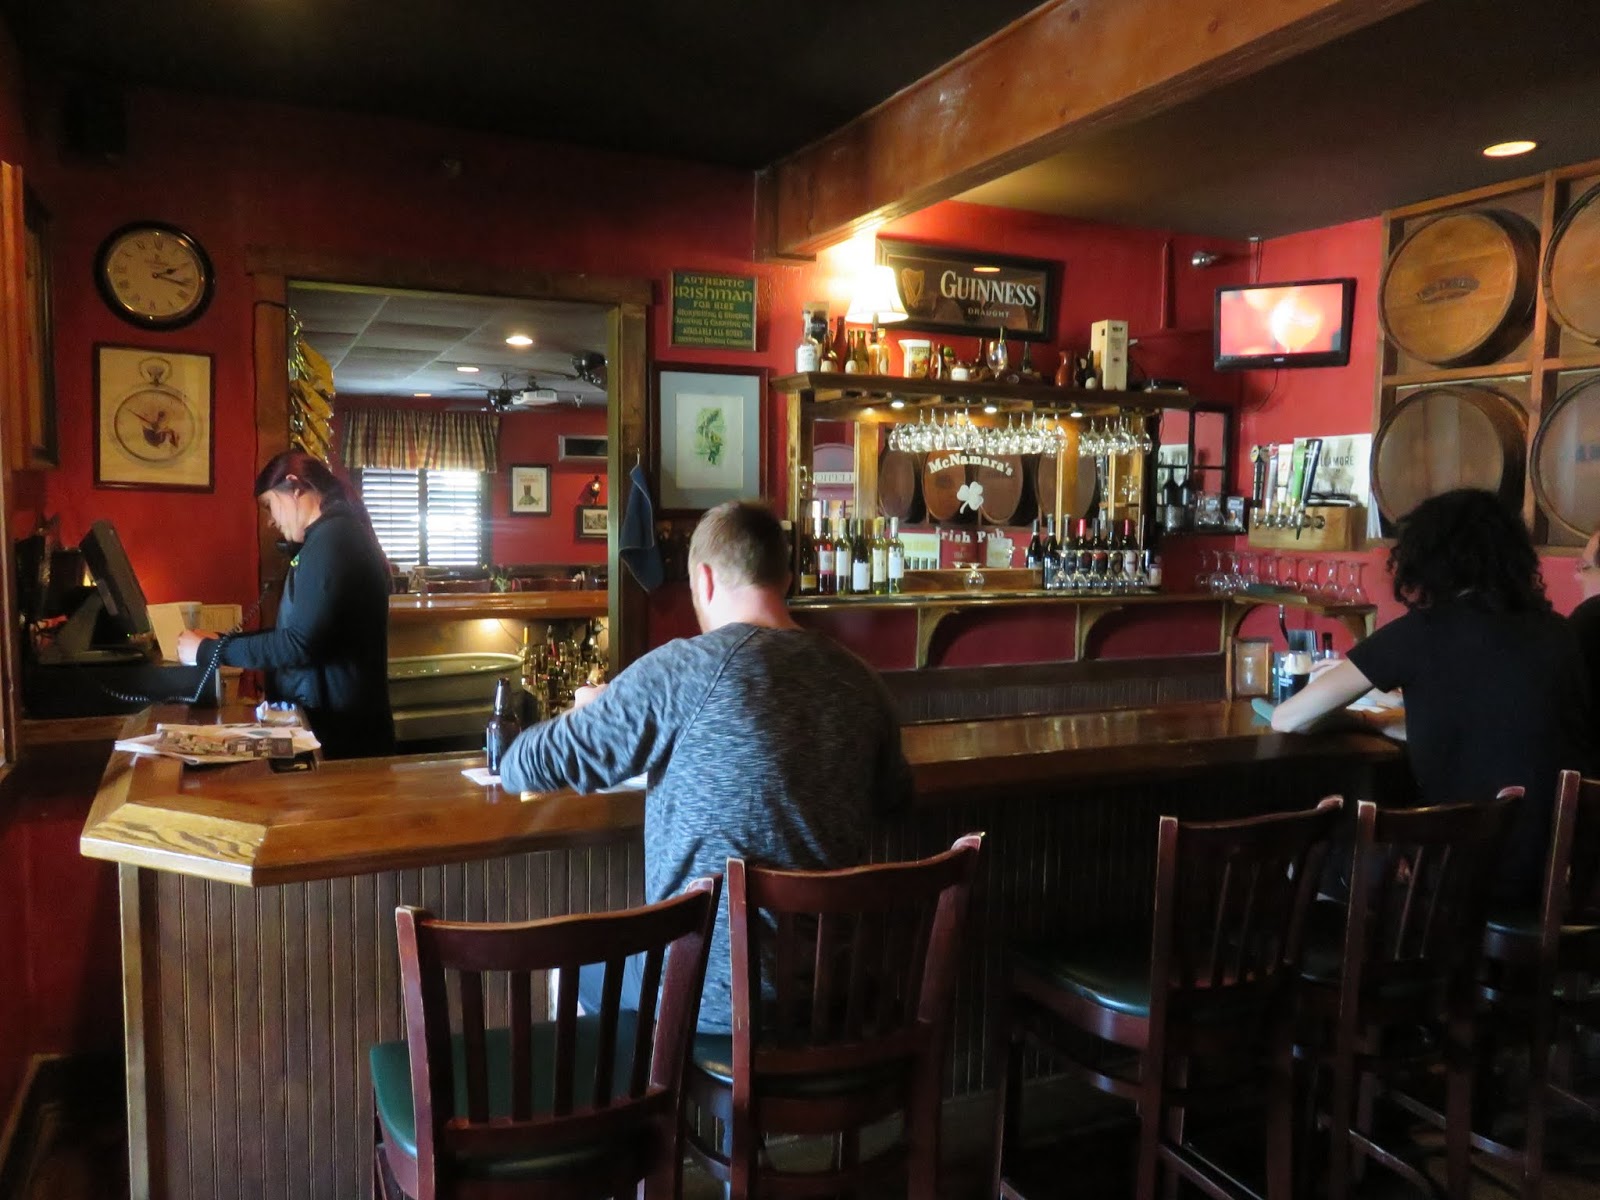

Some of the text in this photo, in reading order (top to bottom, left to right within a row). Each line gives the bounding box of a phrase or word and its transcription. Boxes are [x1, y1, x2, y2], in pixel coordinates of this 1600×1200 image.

[684, 276, 744, 288] AUTHENTIC
[940, 270, 1036, 307] GUINNESS
[694, 301, 711, 309] FOR
[968, 307, 1009, 318] DRAUGHT
[928, 453, 1013, 477] McNamara's
[935, 526, 1004, 543] Irish Pub
